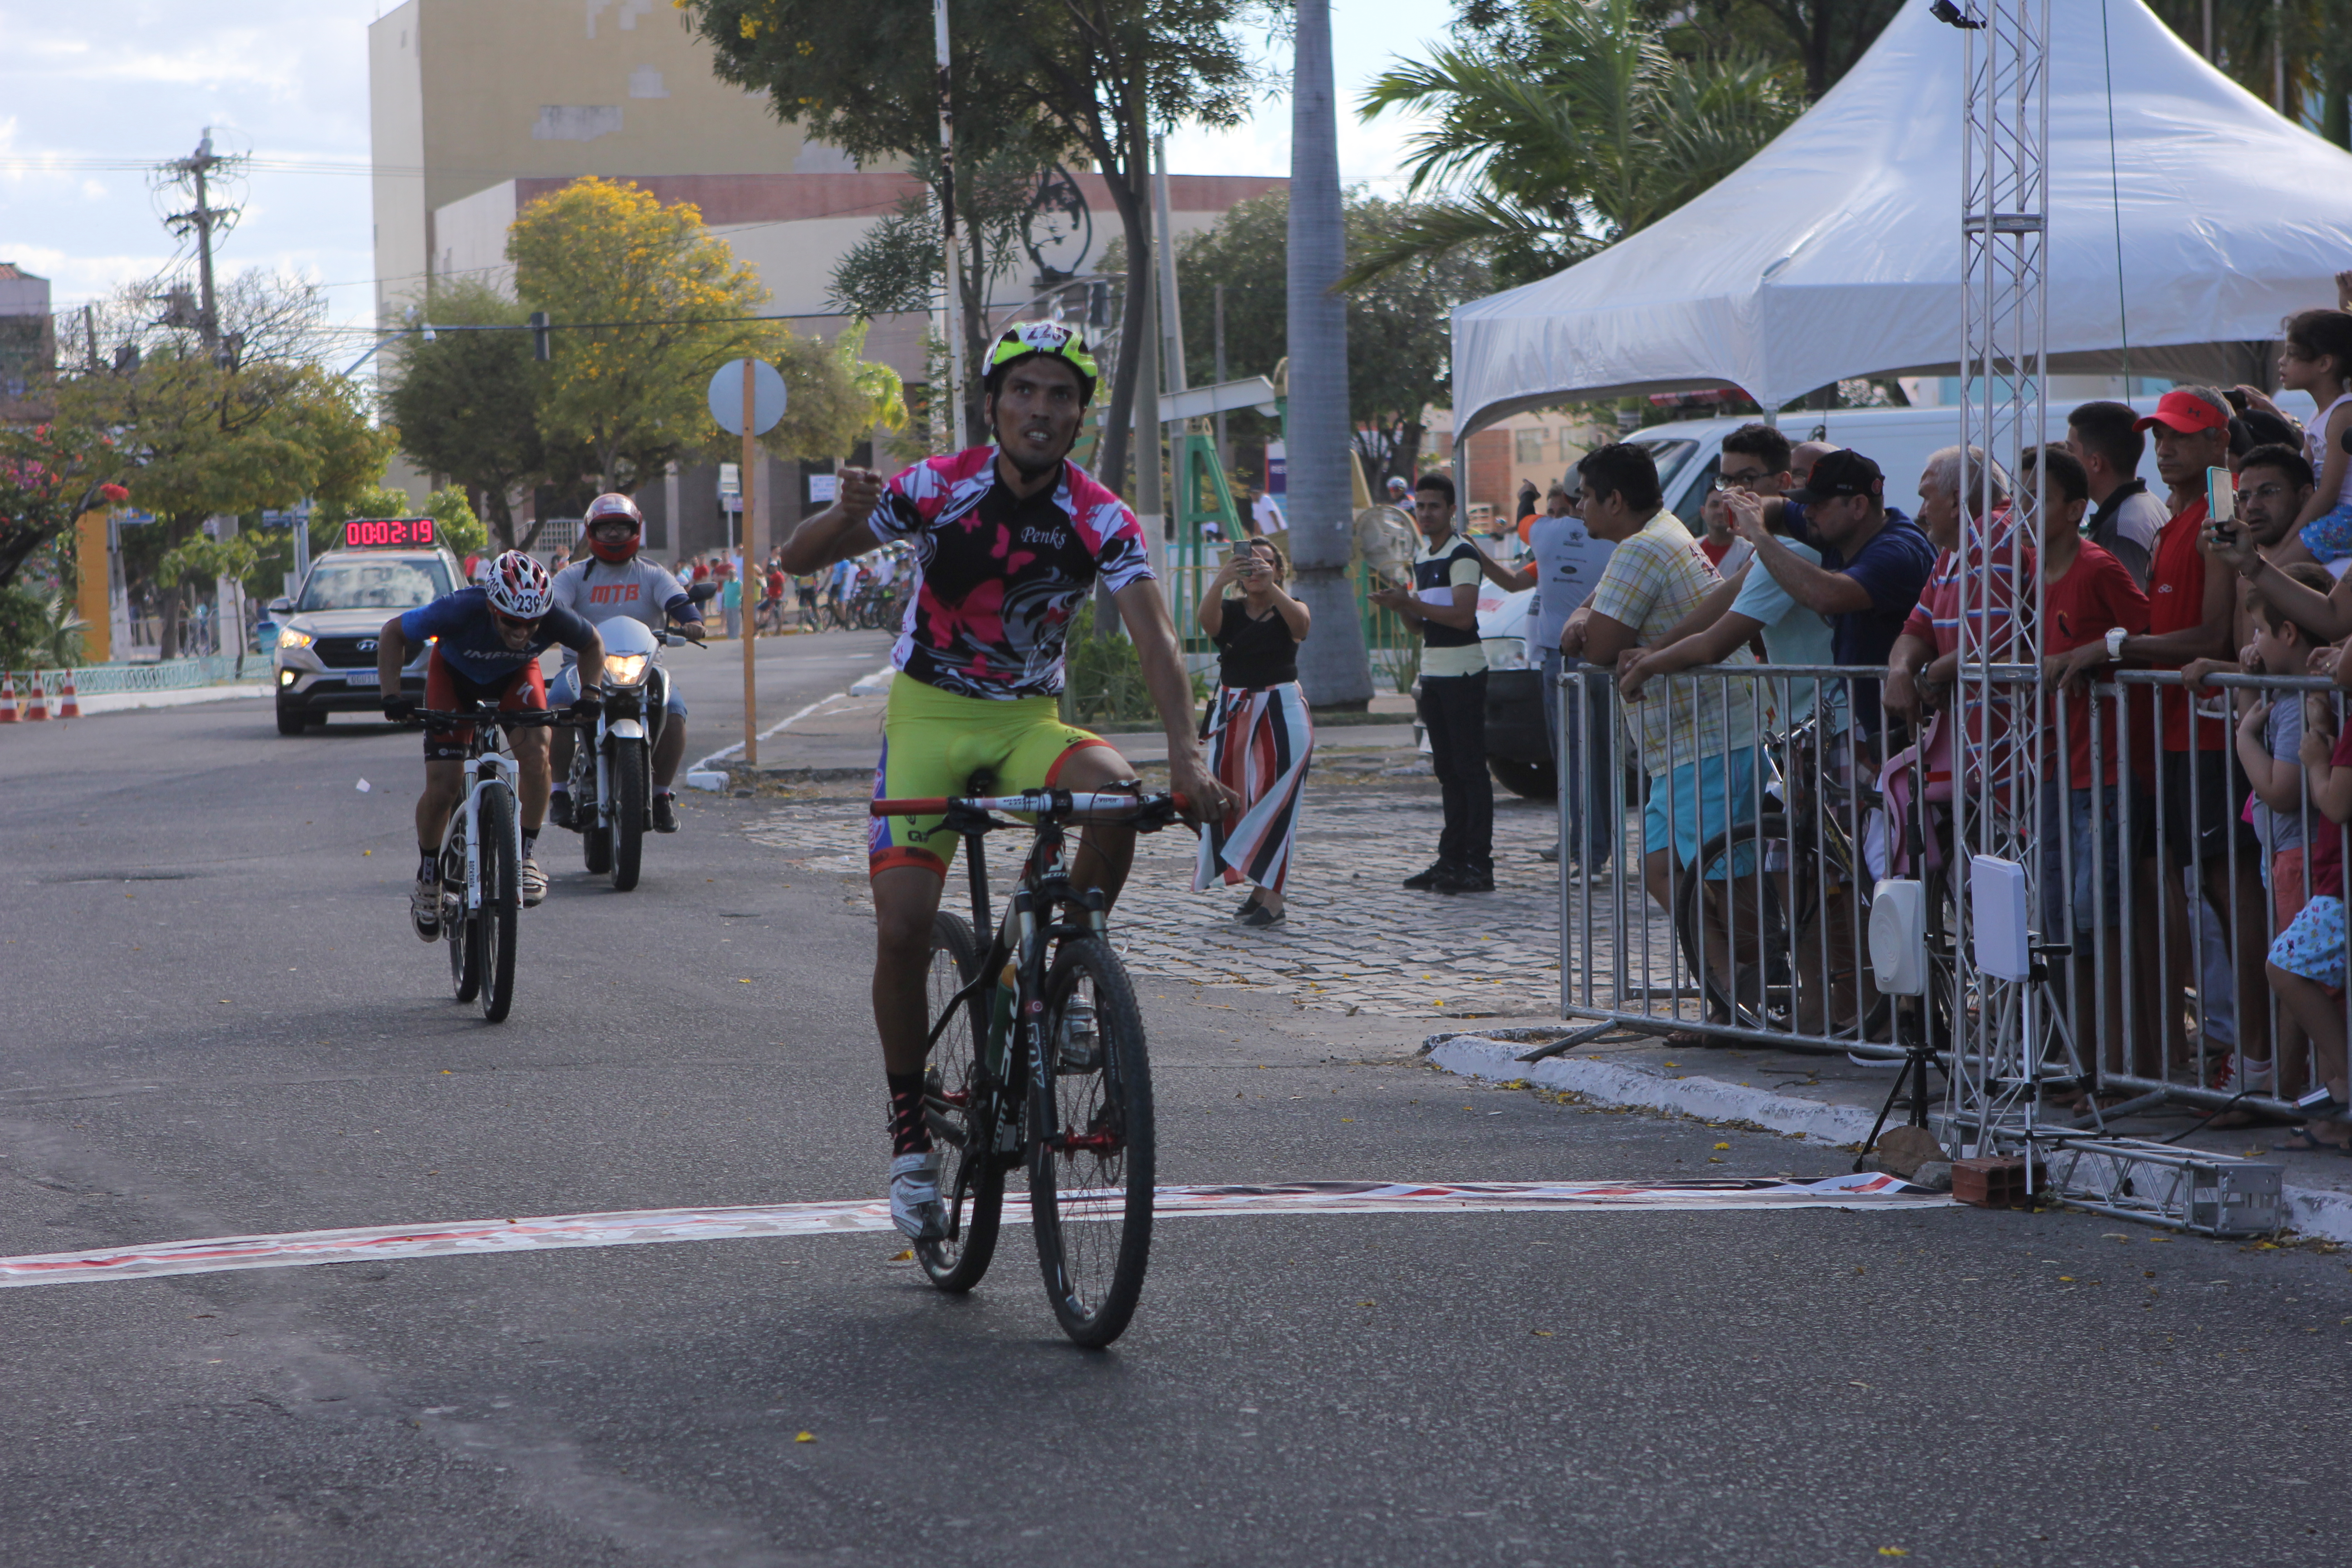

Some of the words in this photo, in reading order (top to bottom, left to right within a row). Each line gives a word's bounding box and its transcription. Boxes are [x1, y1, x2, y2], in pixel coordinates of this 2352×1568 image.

[347, 520, 432, 545] 00:02:19
[1021, 526, 1066, 549] Penks
[516, 594, 540, 613] 239
[590, 584, 640, 604] MTB
[1041, 872, 1070, 880] SCOTT
[991, 1098, 1009, 1155] SCOTT
